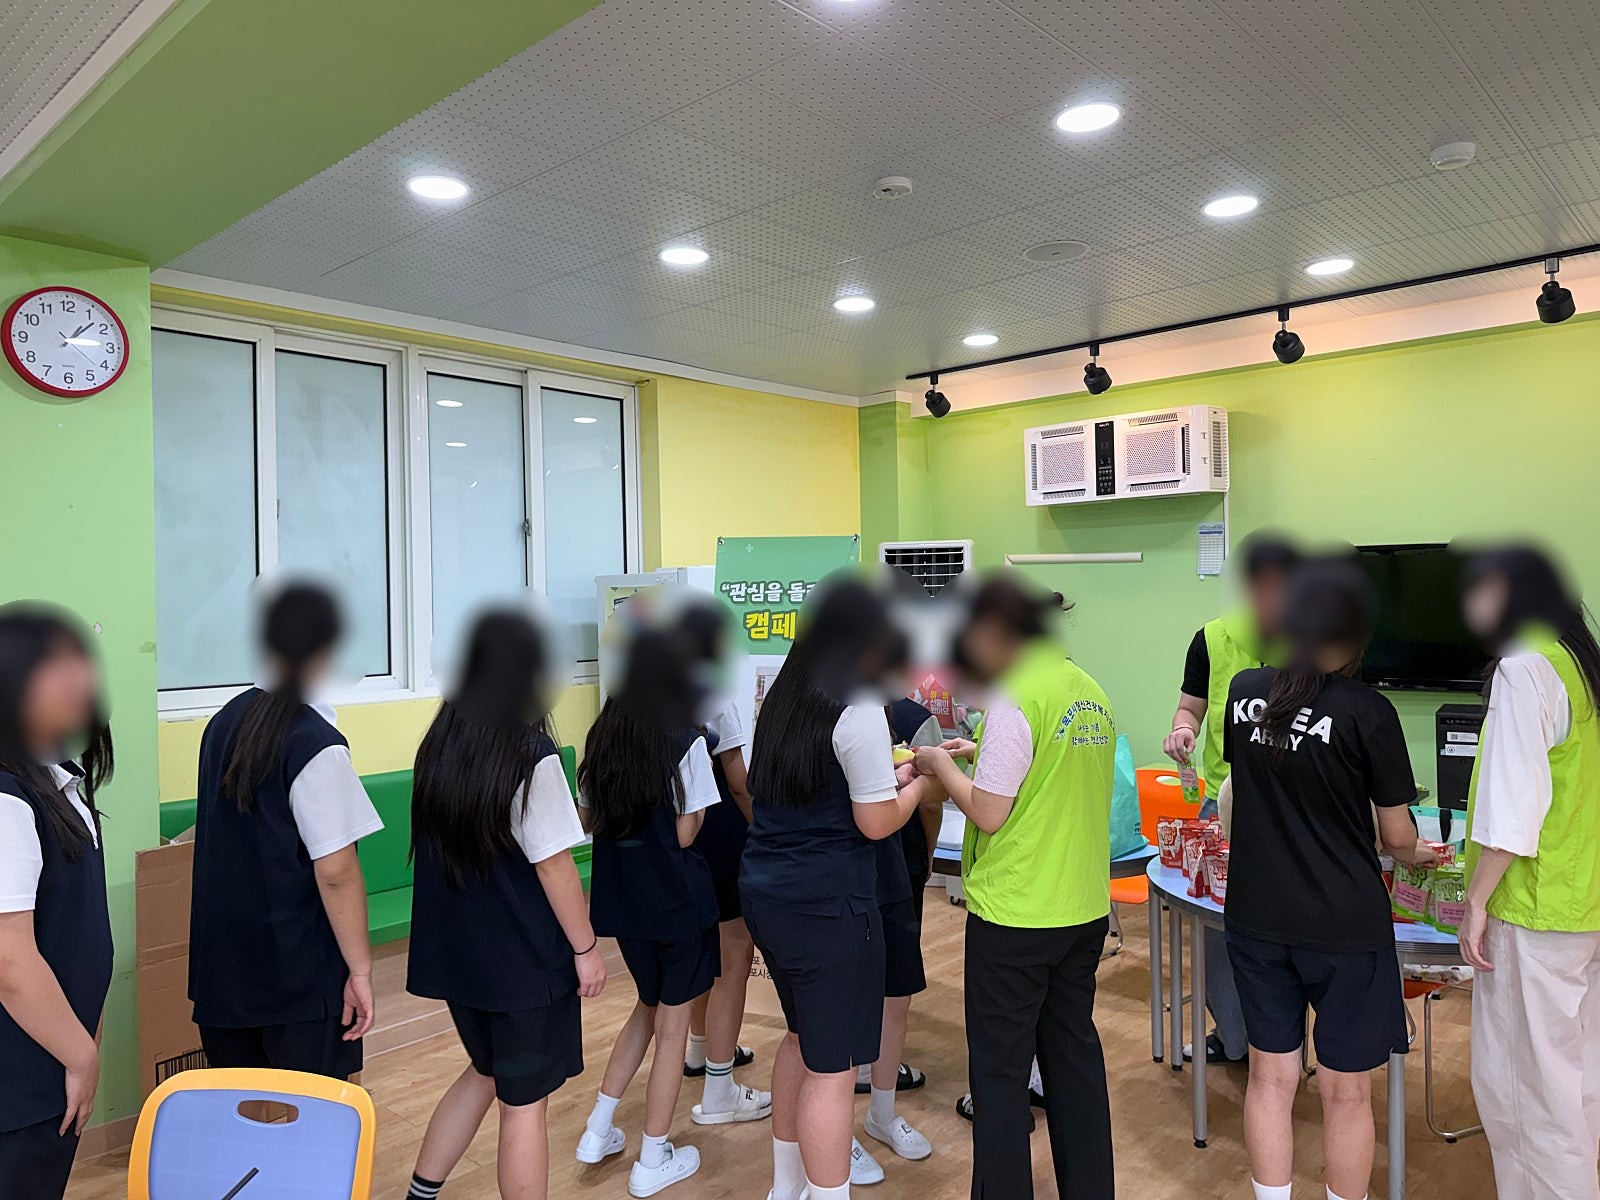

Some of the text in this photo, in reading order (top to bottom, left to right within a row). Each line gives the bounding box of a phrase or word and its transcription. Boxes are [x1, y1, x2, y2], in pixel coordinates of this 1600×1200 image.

[39, 302, 52, 315] 11
[60, 300, 75, 313] 12
[23, 313, 39, 326] 10
[85, 309, 91, 320] 1
[99, 323, 108, 335] 2
[18, 331, 28, 343] 9
[106, 342, 115, 354] 3
[26, 350, 36, 362] 8
[42, 364, 52, 376] 7
[100, 360, 109, 371] 4
[63, 372, 73, 384] 6
[85, 370, 95, 381] 5
[745, 611, 796, 640] 캠페
[1233, 698, 1333, 744] KOEA
[1249, 727, 1304, 751] ARY
